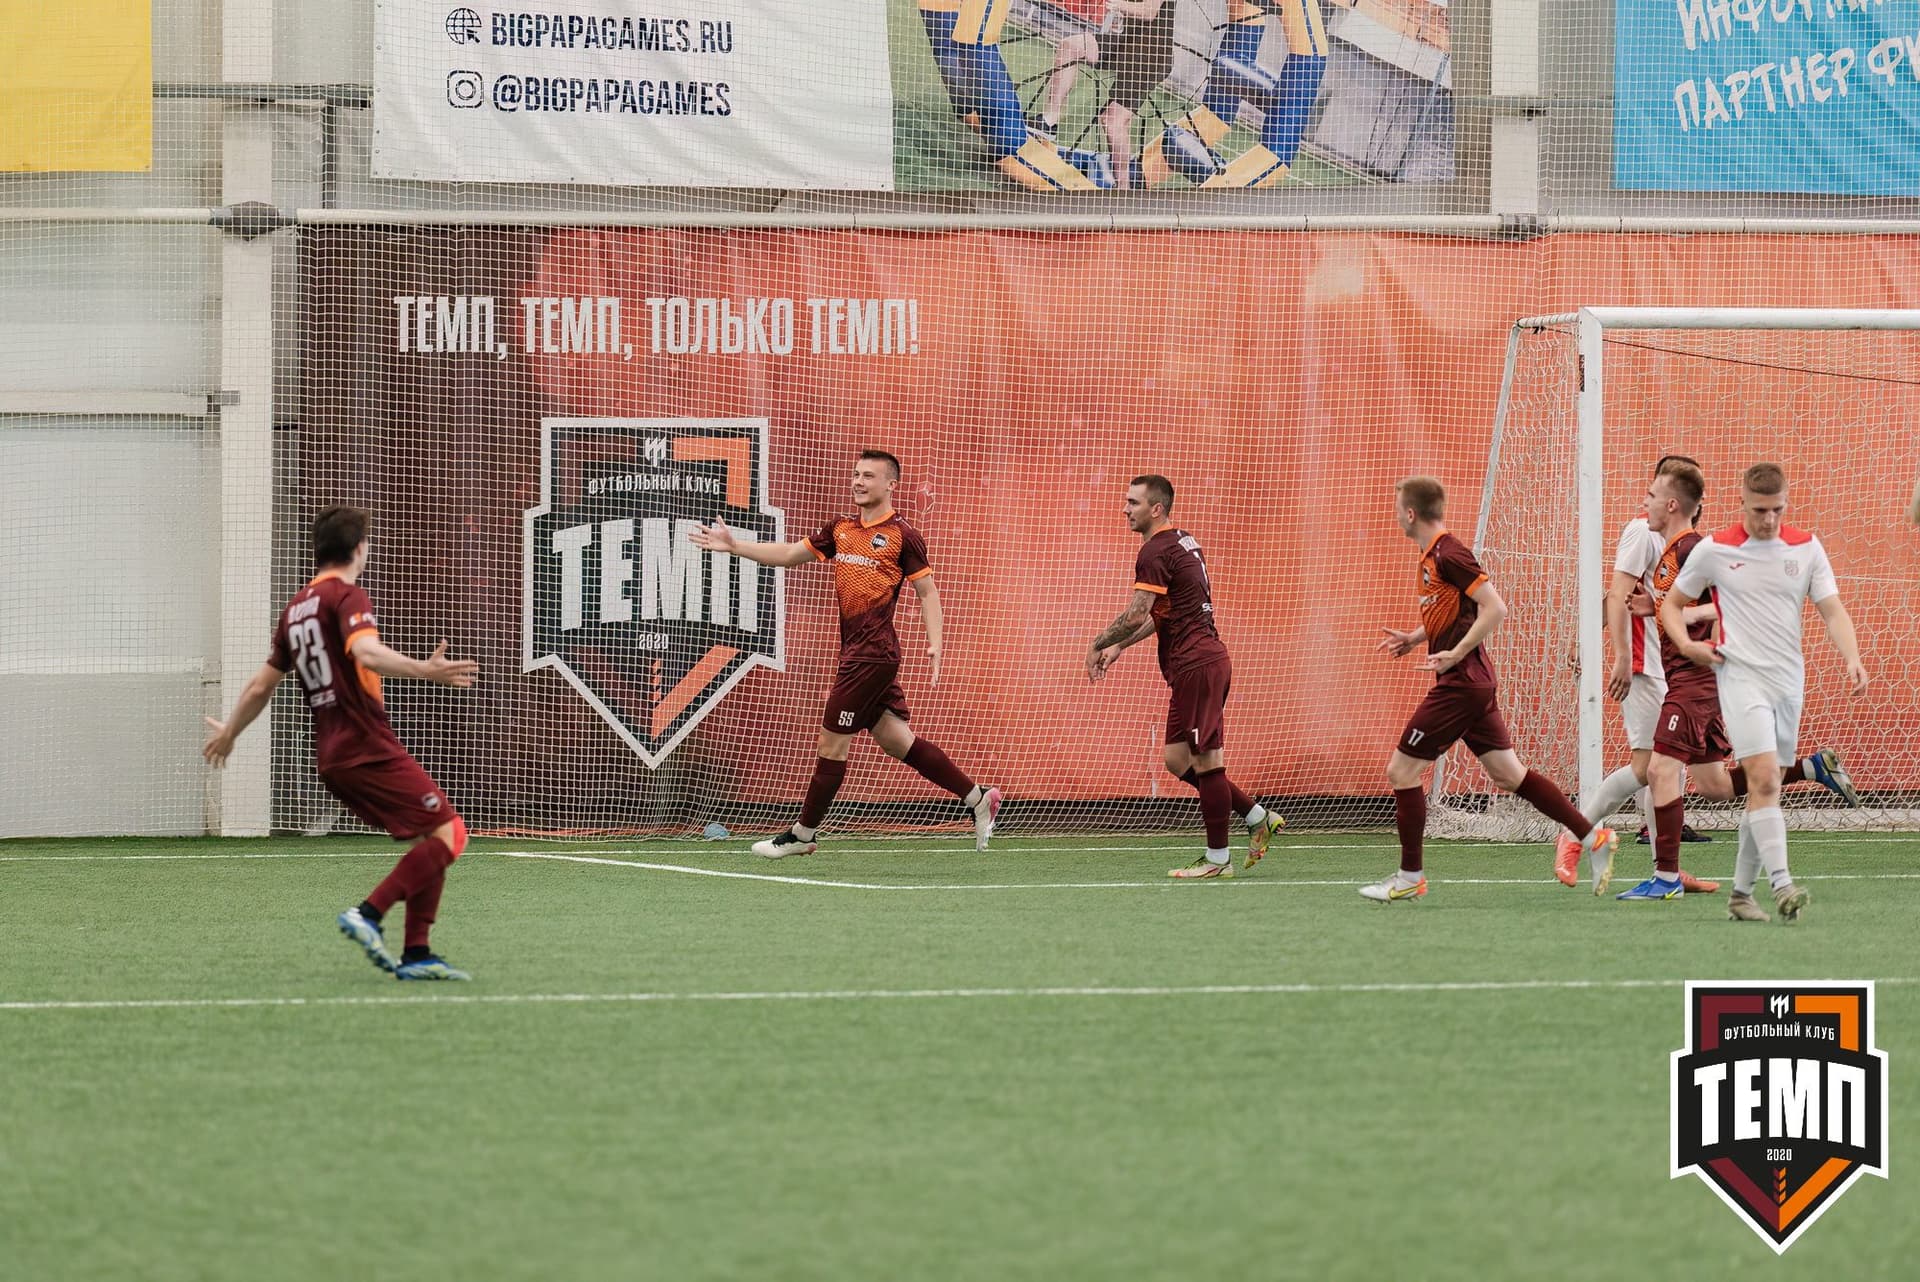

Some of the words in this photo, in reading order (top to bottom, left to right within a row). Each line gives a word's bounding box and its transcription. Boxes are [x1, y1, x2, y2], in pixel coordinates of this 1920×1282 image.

[491, 12, 733, 54] BIGPAPAGAMES.RU
[492, 74, 732, 117] @BIGPAPAGAMES
[1674, 48, 1856, 132] ПАРТНЕР
[393, 296, 508, 361] ТЕМП,
[520, 297, 633, 361] ТЕМП,
[645, 297, 793, 355] ТОЛЬКО
[806, 298, 919, 356] ТЕМП!
[588, 471, 680, 496] ФУТБОЛЬНЫЙ
[685, 475, 720, 495] КЛУБ
[552, 517, 758, 634] ТЕМП
[288, 617, 333, 692] 23
[638, 633, 669, 650] 2020
[1407, 728, 1425, 747] 17
[1668, 714, 1679, 731] 6
